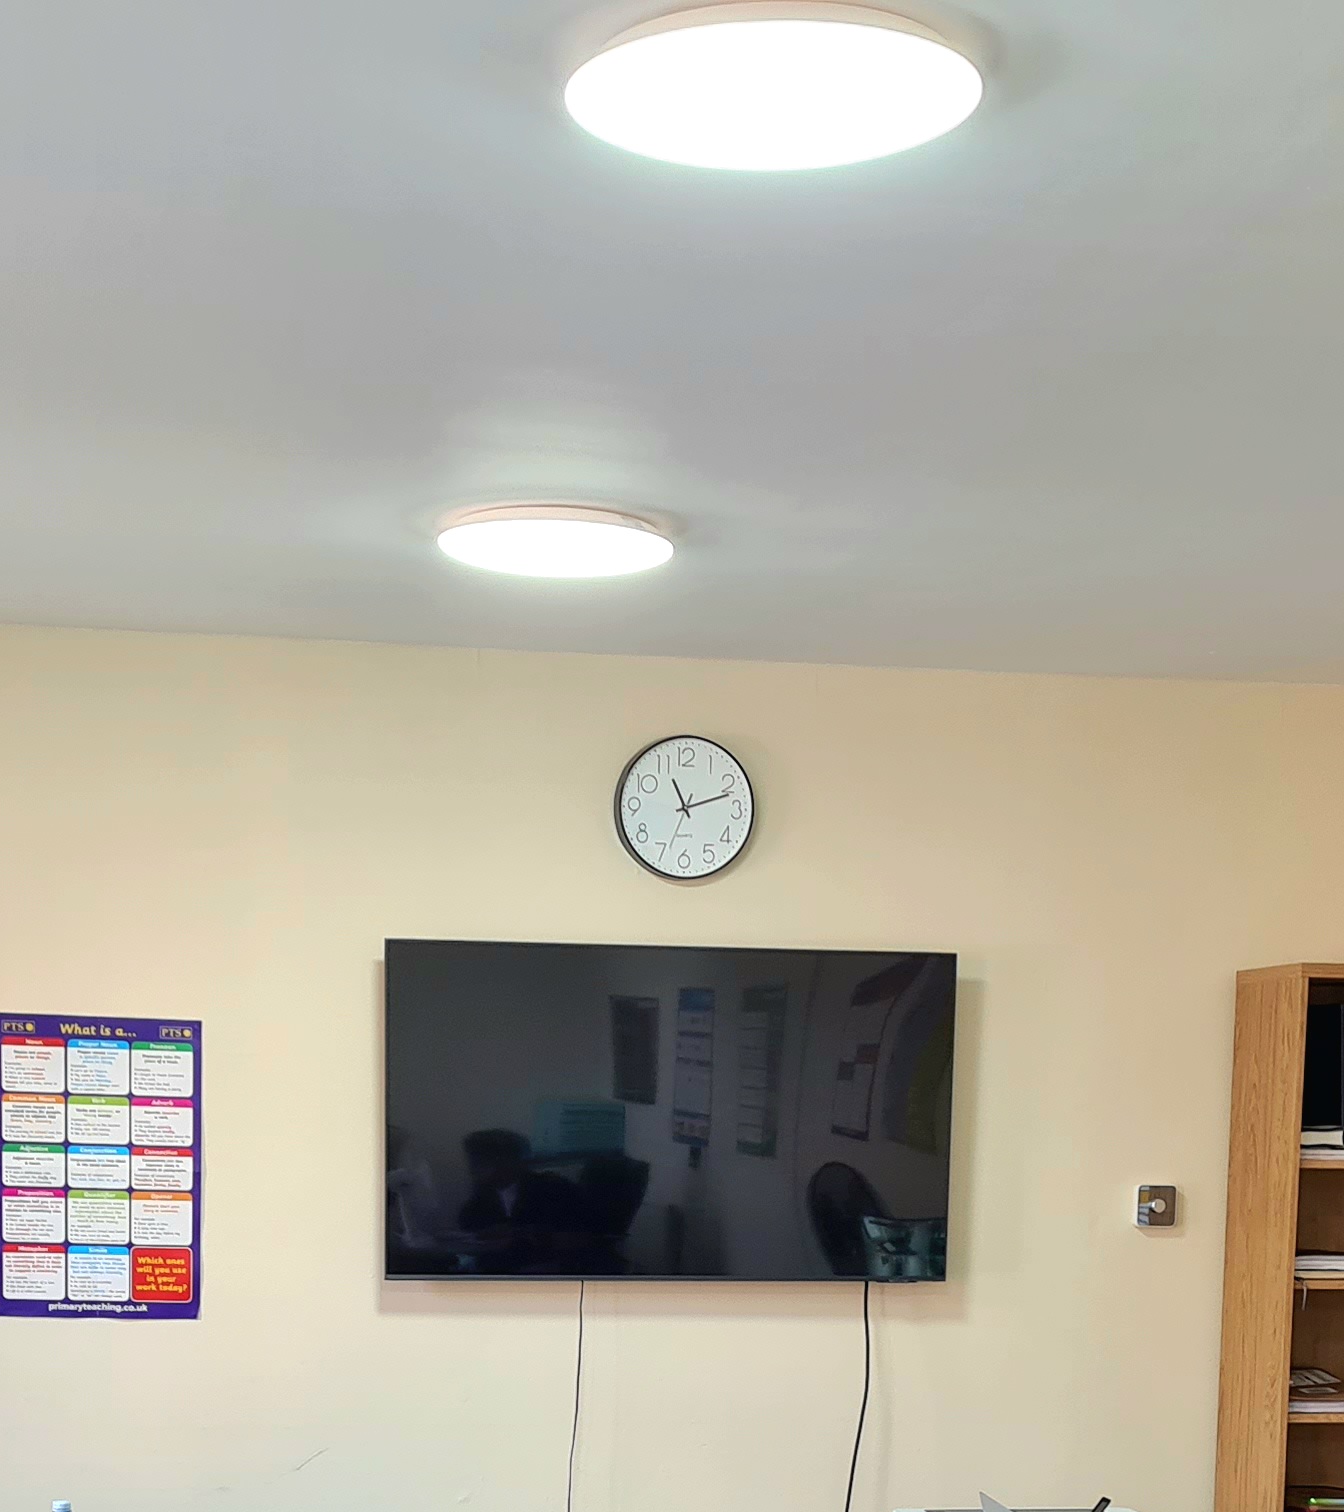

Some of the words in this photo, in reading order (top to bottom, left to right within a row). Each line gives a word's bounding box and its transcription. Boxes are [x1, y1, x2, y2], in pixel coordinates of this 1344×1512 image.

[657, 754, 670, 775] 11
[677, 746, 695, 768] 12
[708, 754, 713, 775] 1
[636, 773, 658, 794] 10
[721, 773, 735, 793] 2
[627, 796, 641, 817] 9
[730, 799, 743, 820] 3
[636, 822, 649, 844] 8
[719, 825, 732, 844] 4
[655, 842, 667, 862] 7
[677, 849, 691, 869] 6
[702, 843, 715, 864] 5
[3, 1022, 24, 1031] PTS
[60, 1023, 96, 1035] What
[100, 1024, 111, 1036] is
[116, 1030, 136, 1038] a...
[161, 1028, 182, 1037] PTS
[136, 1265, 153, 1274] will
[154, 1267, 170, 1276] you
[137, 1256, 164, 1265] Which
[136, 1283, 157, 1291] work
[159, 1284, 187, 1293] today?
[146, 1274, 156, 1282] in
[157, 1275, 176, 1284] your
[48, 1302, 149, 1313] primaryteaching.co.uk
